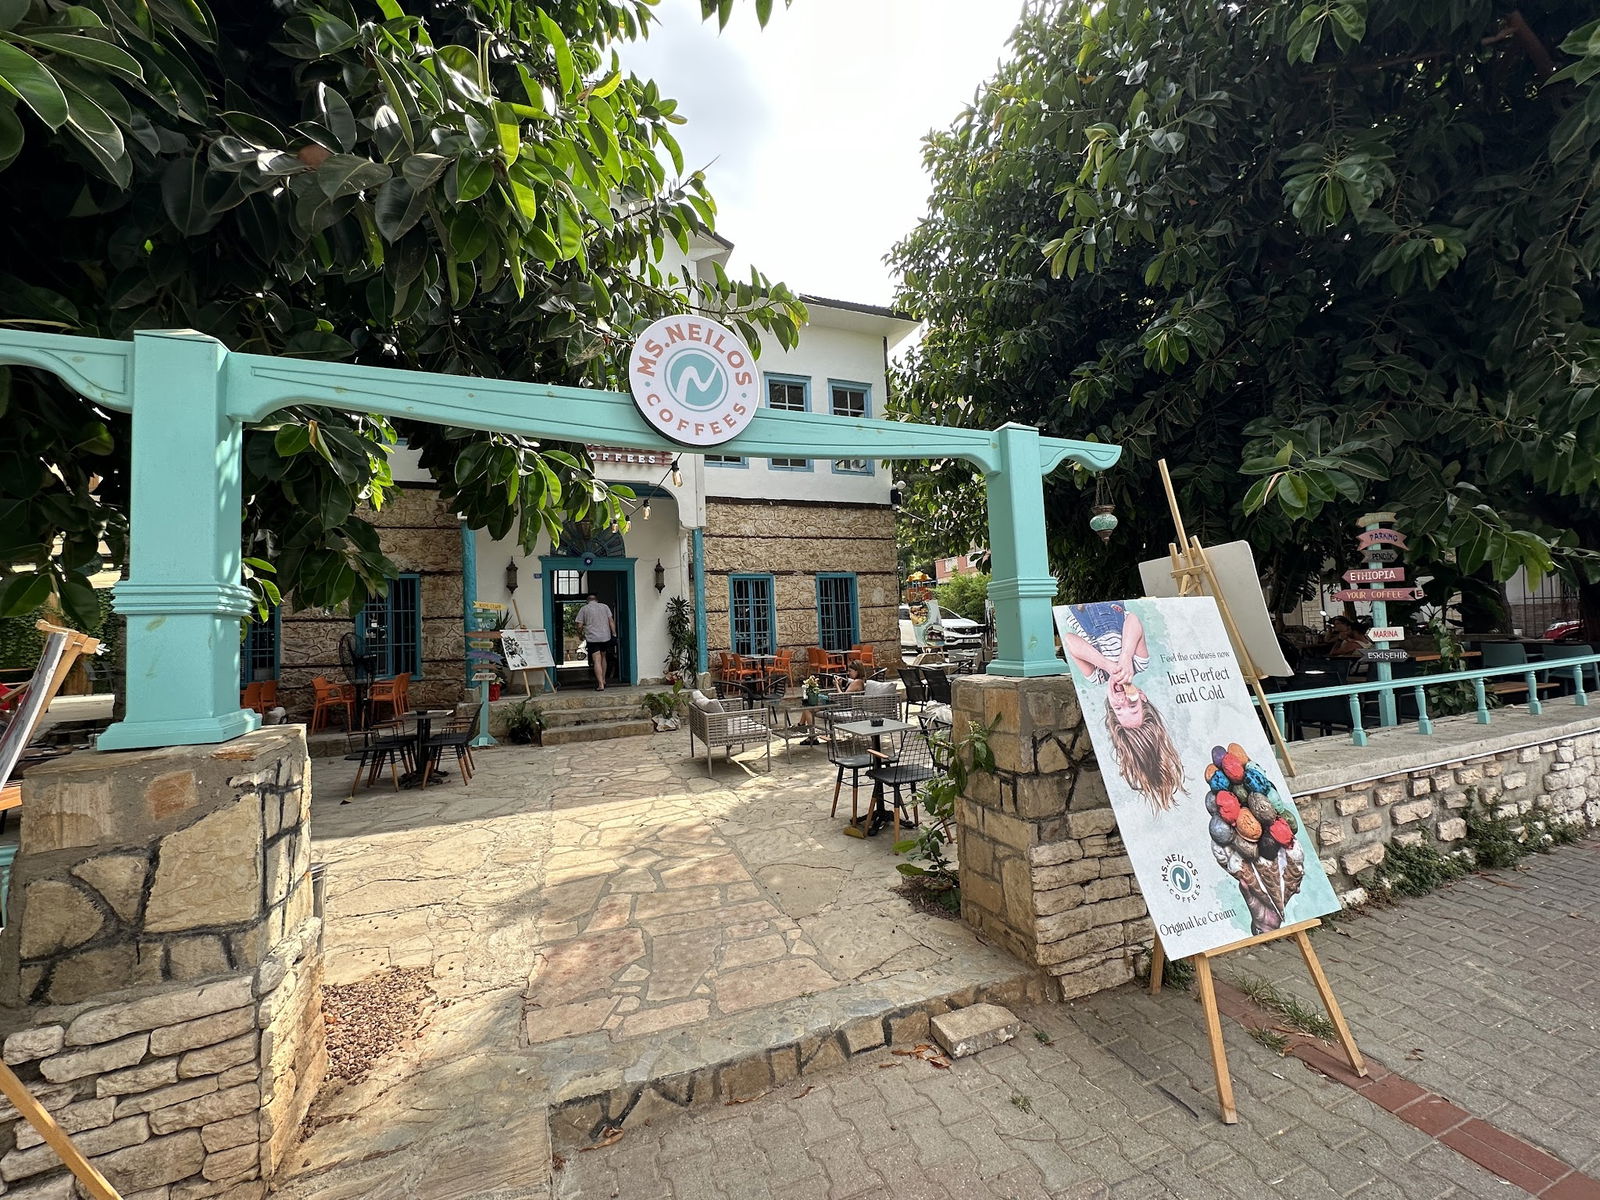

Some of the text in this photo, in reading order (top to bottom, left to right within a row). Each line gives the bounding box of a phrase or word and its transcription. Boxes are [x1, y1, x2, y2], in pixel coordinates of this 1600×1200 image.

[646, 393, 747, 436] COFFEES
[588, 452, 656, 464] OFFEES
[1346, 591, 1367, 599] YOUR
[1371, 591, 1402, 599] COFFEE
[1373, 630, 1399, 638] MARINA
[1160, 653, 1177, 663] Feel
[1177, 652, 1188, 661] the
[1189, 651, 1216, 661] coolness
[1190, 667, 1230, 682] Perfect
[1175, 684, 1225, 704] and Cold
[1169, 883, 1201, 904] COFFEES
[1159, 908, 1237, 936] Original Ice Cream
